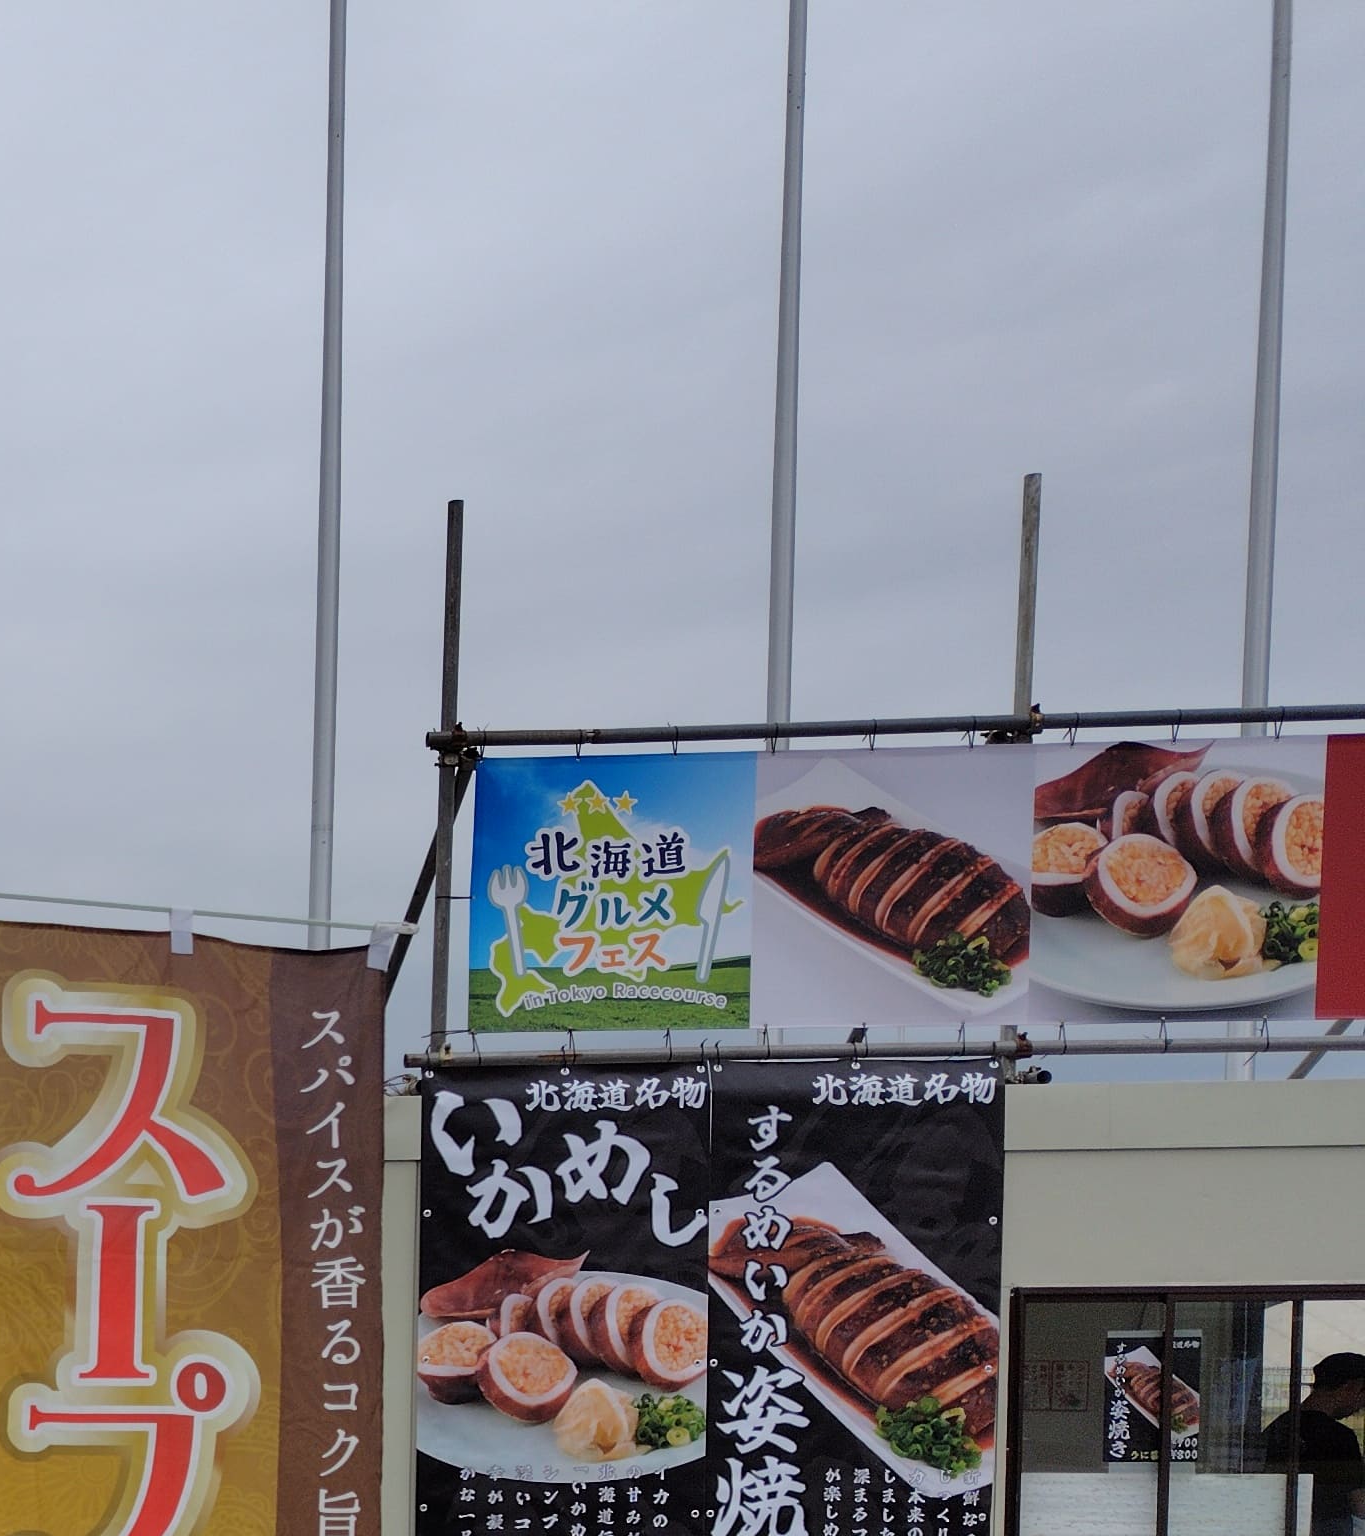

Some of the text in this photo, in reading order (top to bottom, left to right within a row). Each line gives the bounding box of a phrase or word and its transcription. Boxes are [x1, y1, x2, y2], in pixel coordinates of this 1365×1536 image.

[528, 829, 686, 879] 北海道
[554, 883, 673, 926] グルメ
[561, 933, 670, 971] フェス
[523, 979, 730, 1011] in Tokyo Racecourse
[525, 1079, 707, 1113] 北海道名物
[812, 1074, 997, 1107] 北海道名物
